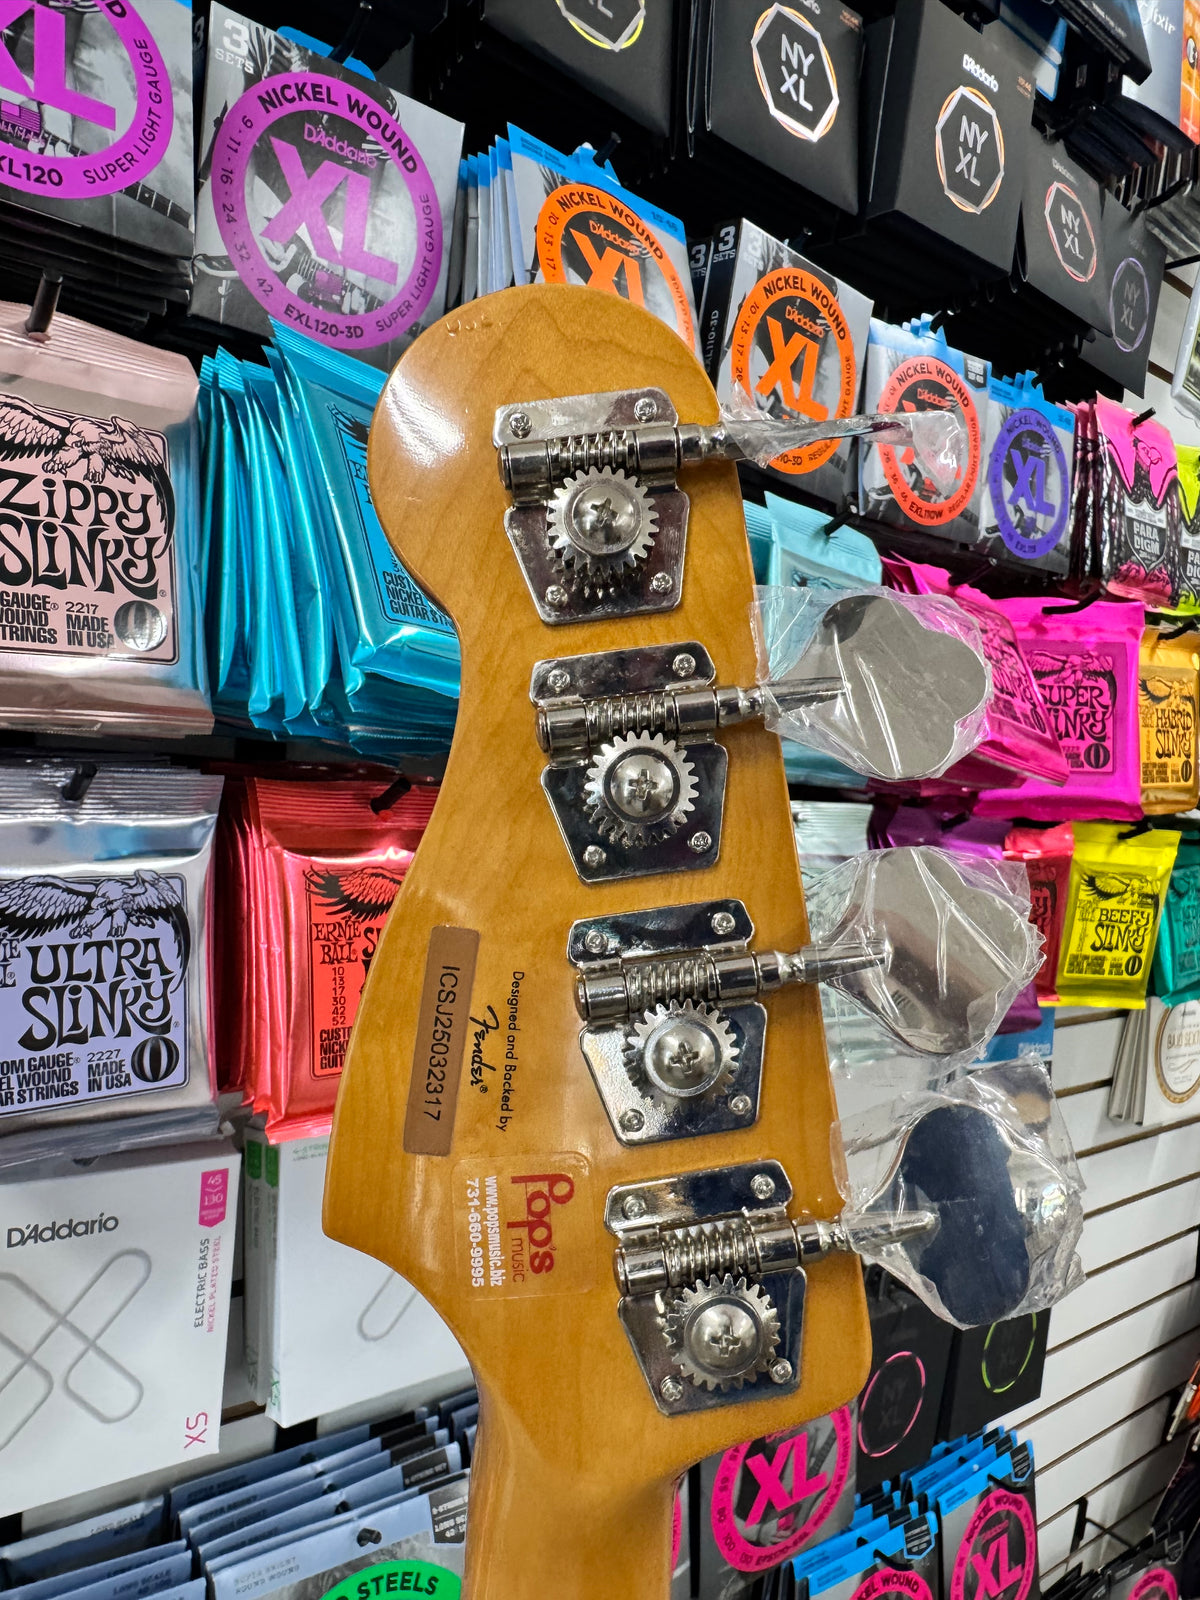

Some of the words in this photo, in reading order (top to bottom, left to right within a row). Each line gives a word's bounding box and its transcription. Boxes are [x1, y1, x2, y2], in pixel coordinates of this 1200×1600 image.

[223, 18, 249, 55] 3
[214, 48, 254, 74] SETS
[781, 34, 815, 76] NY
[133, 38, 162, 104] GAUGE
[780, 65, 813, 111] XL
[133, 107, 162, 156] LIGHT
[257, 82, 339, 114] NICKEL
[346, 93, 418, 174] WOUND
[960, 115, 989, 154] NY
[83, 151, 139, 184] SUPER
[220, 167, 234, 184] 16
[955, 146, 981, 187] XL
[221, 203, 237, 224] 24
[260, 135, 398, 285] XL
[419, 193, 435, 252] GAUGE
[556, 191, 606, 212] NICKEL
[609, 200, 663, 259] WOUND
[1061, 204, 1080, 234] NY
[234, 242, 250, 261] 32
[718, 226, 736, 250] 3
[1063, 228, 1084, 260] XL
[546, 257, 556, 270] 17
[690, 244, 706, 268] 3
[713, 249, 736, 263] SETS
[256, 277, 274, 297] 42
[413, 259, 433, 301] LIGHT
[1124, 281, 1140, 306] NY
[283, 303, 364, 339] EXL120-3D
[375, 301, 413, 332] SUPER
[763, 275, 807, 299] NICKEL
[811, 283, 846, 340] WOUND
[1120, 303, 1135, 331] XL
[755, 315, 829, 422] XL
[896, 363, 932, 386] NICKEL
[936, 365, 969, 407] WOUND
[1008, 448, 1056, 518] XL
[65, 601, 99, 615] 2217
[386, 585, 427, 607] NICKEL
[390, 599, 430, 621] GUITAR
[66, 614, 109, 633] MADE
[67, 631, 83, 646] IN
[86, 632, 116, 649] USA
[1099, 908, 1150, 927] BEEFY
[26, 937, 175, 985] ULTRA
[332, 966, 346, 976] 10
[332, 986, 346, 996] 17
[332, 996, 346, 1006] 30
[508, 971, 525, 1031] Designed
[332, 1006, 346, 1016] 42
[332, 1016, 346, 1026] 52
[87, 1049, 121, 1062] 2227
[424, 966, 460, 1121] ICSJ25032317
[506, 1035, 518, 1060] and
[17, 1067, 71, 1088] WOUND
[88, 1059, 126, 1078] MADE
[88, 1078, 102, 1092] IN
[106, 1073, 132, 1089] USA
[17, 1081, 79, 1104] STRINGS
[502, 1064, 517, 1112] Backed
[495, 1116, 512, 1132] by
[6, 1212, 119, 1248] D'Addario
[466, 1177, 485, 1288] 731-660-9995
[483, 1175, 506, 1287] www.popsmusic.biz
[199, 1238, 210, 1270] BASS
[511, 1237, 525, 1283] music
[194, 1274, 207, 1329] ELECTRIC
[183, 1411, 208, 1449] XS
[744, 1432, 828, 1529] XL
[971, 1532, 1022, 1597] XL
[357, 1571, 440, 1600] STEELS
[881, 1573, 919, 1594] WOUND
